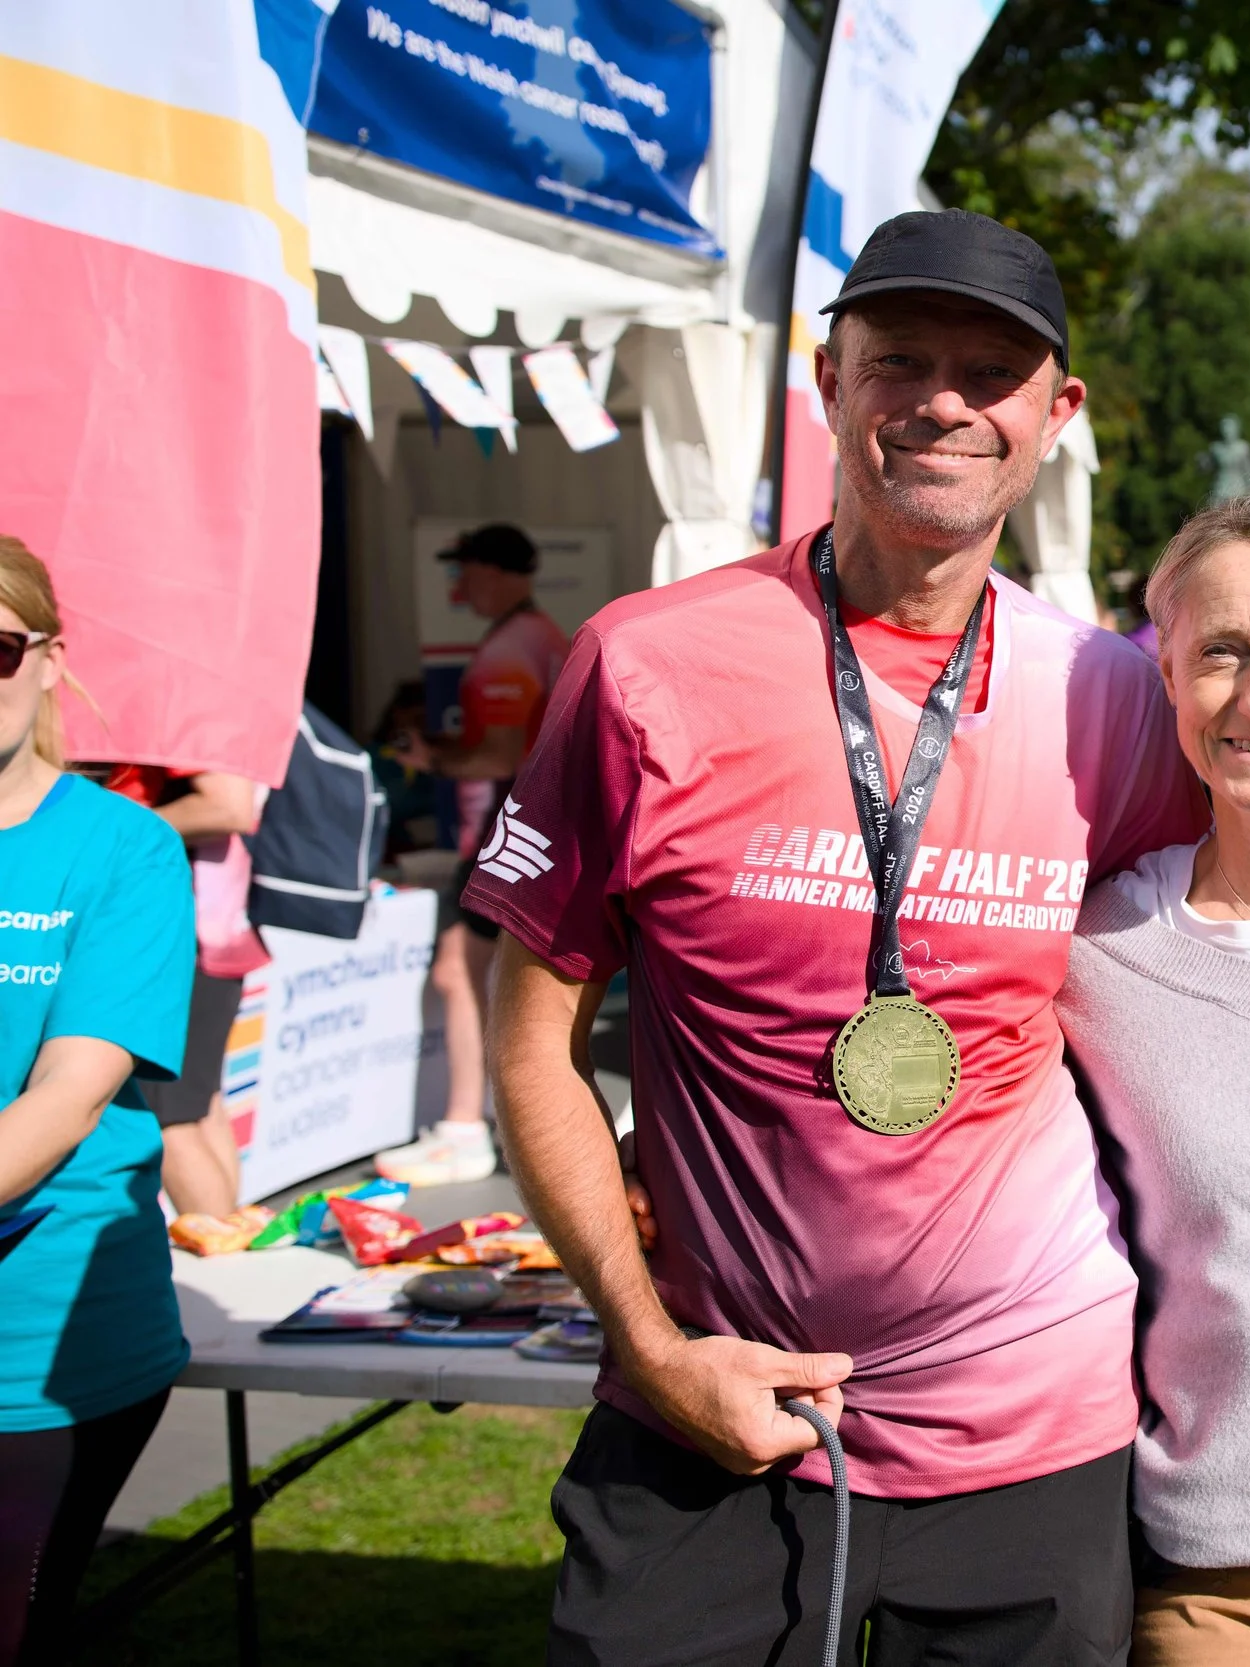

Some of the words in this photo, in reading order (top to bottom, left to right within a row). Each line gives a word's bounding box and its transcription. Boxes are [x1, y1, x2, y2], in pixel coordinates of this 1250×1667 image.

[366, 5, 403, 48] We
[863, 751, 886, 810] CARDIFF
[875, 813, 888, 846] HAL
[903, 786, 925, 826] 2026
[743, 823, 943, 887] CARDF
[938, 848, 1034, 899] HALF
[729, 872, 842, 905] HANNER
[844, 884, 982, 926] MAATHON
